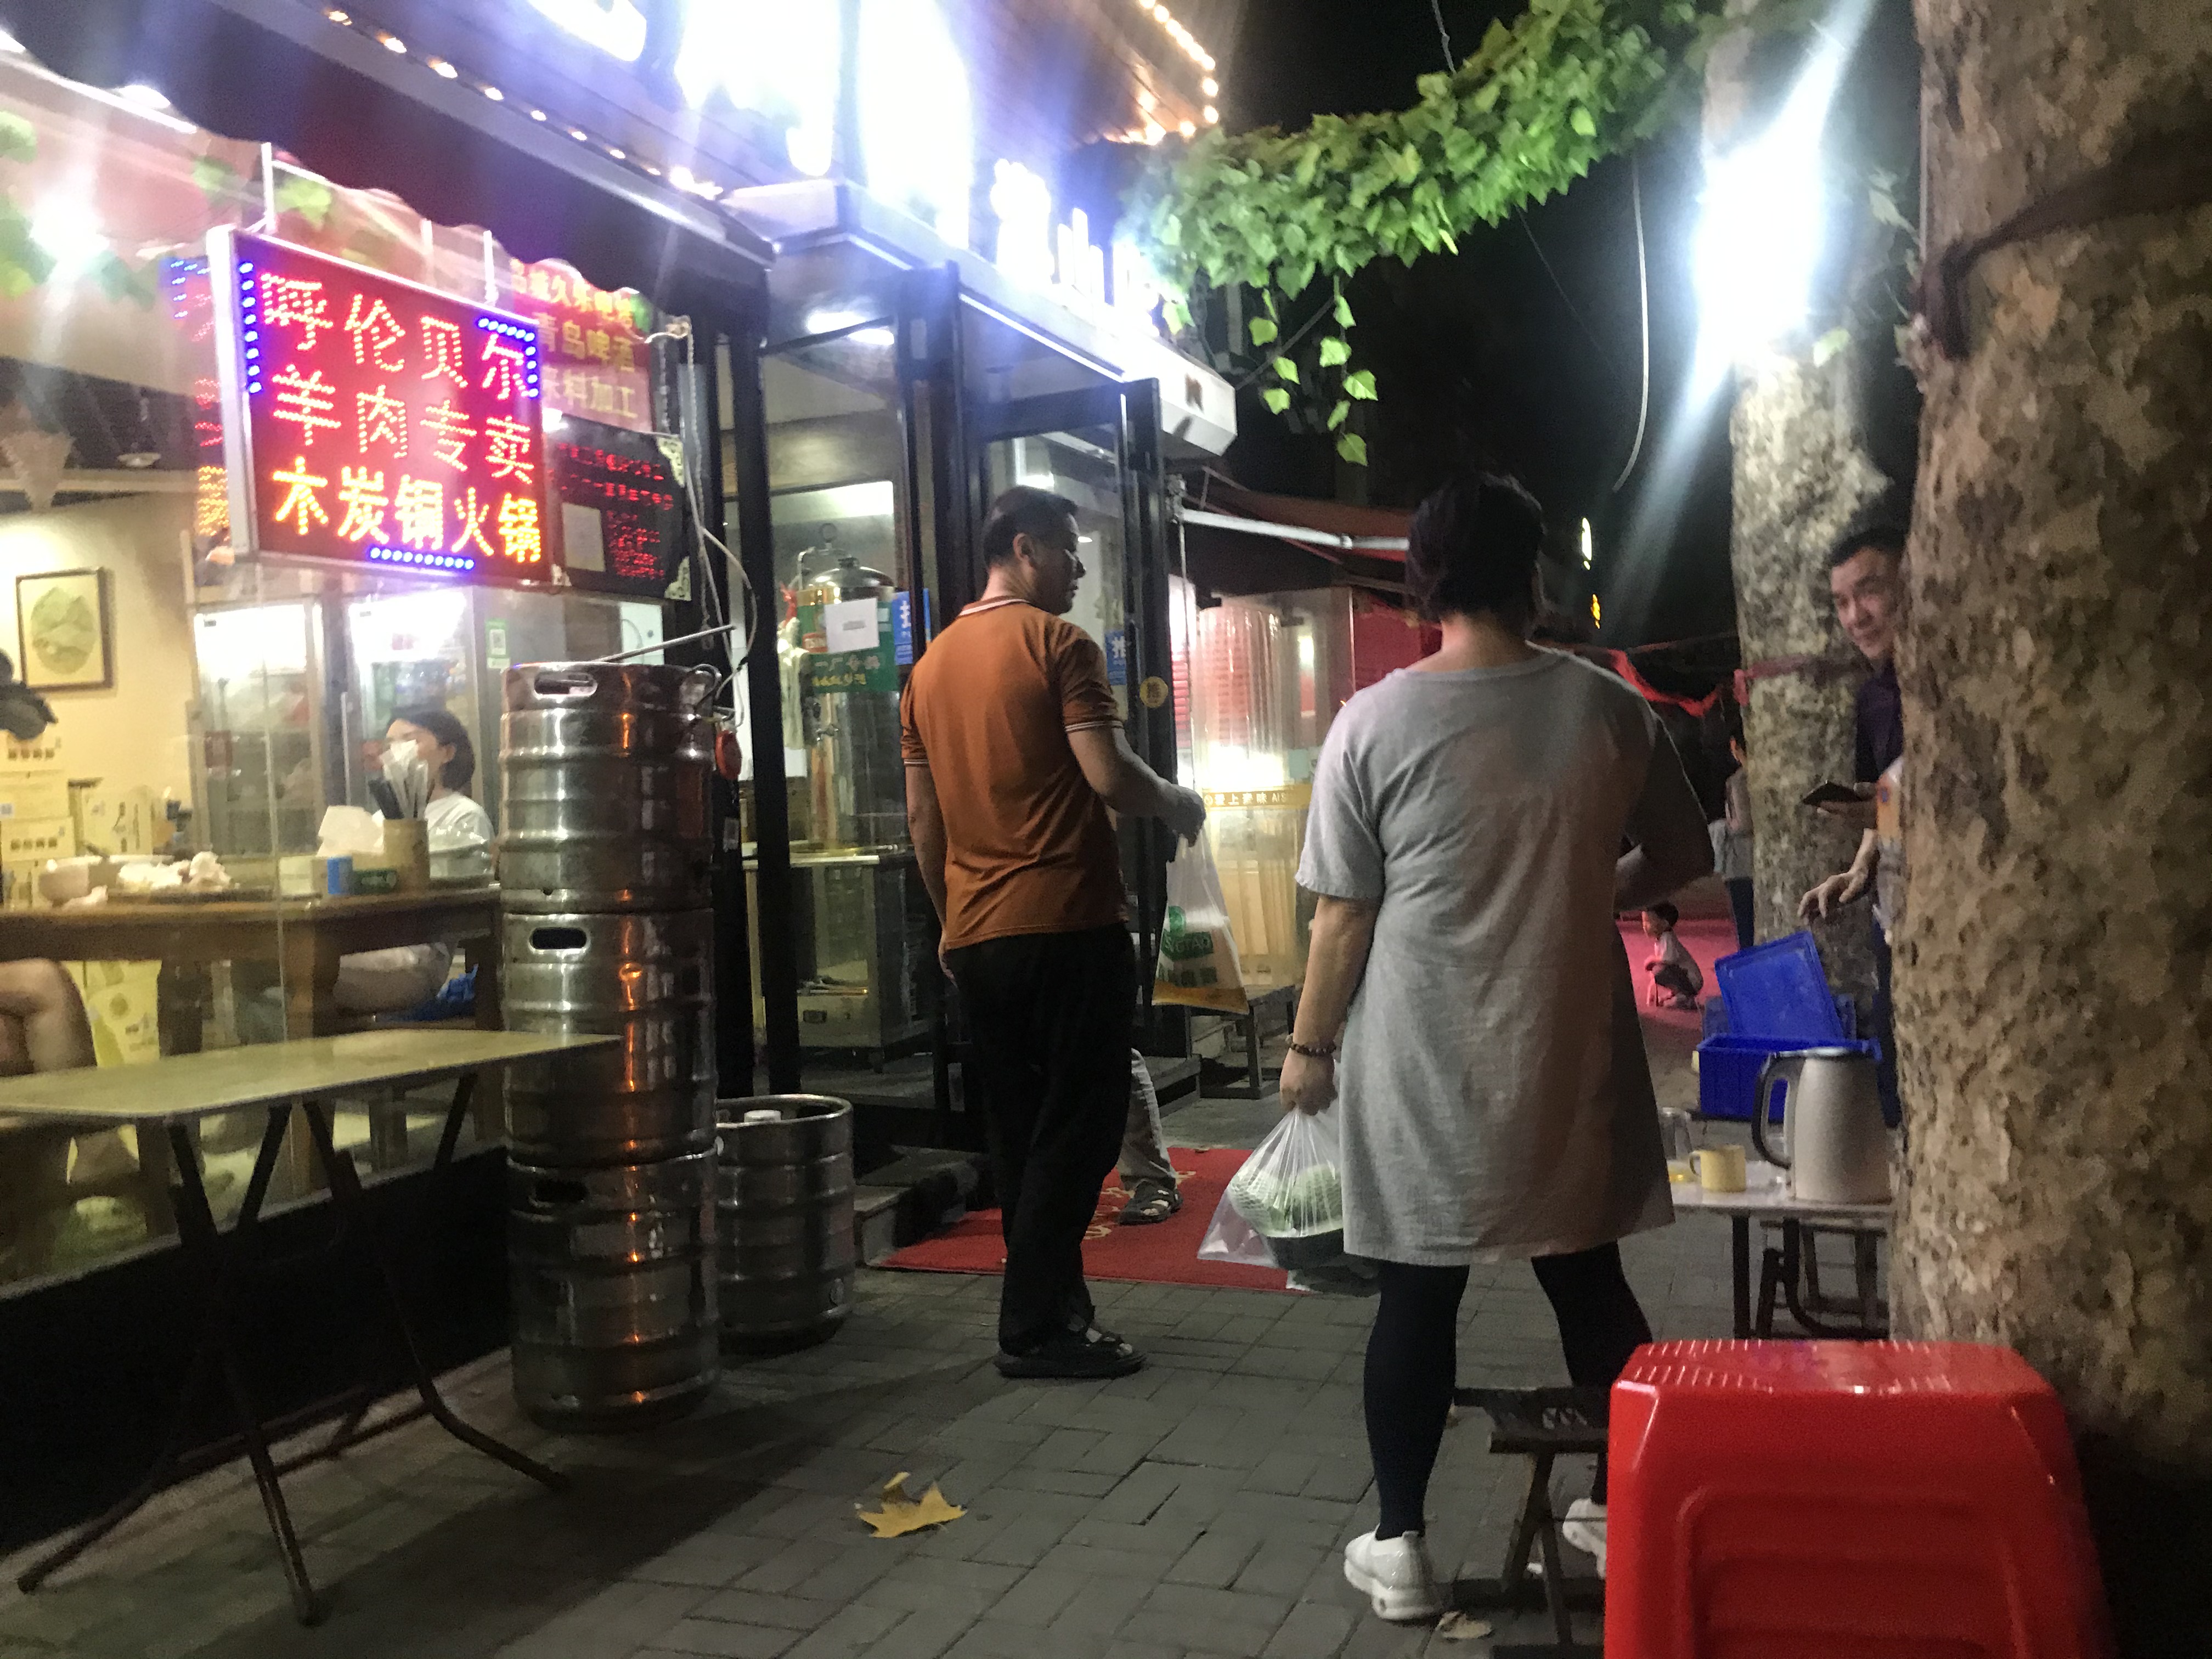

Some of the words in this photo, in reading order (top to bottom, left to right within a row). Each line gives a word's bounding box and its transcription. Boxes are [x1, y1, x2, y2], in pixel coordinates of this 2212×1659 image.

[261, 273, 528, 399] 呼伦贝尔
[272, 364, 535, 485] 羊肉专卖
[272, 455, 542, 563] 木炭铜火锅
